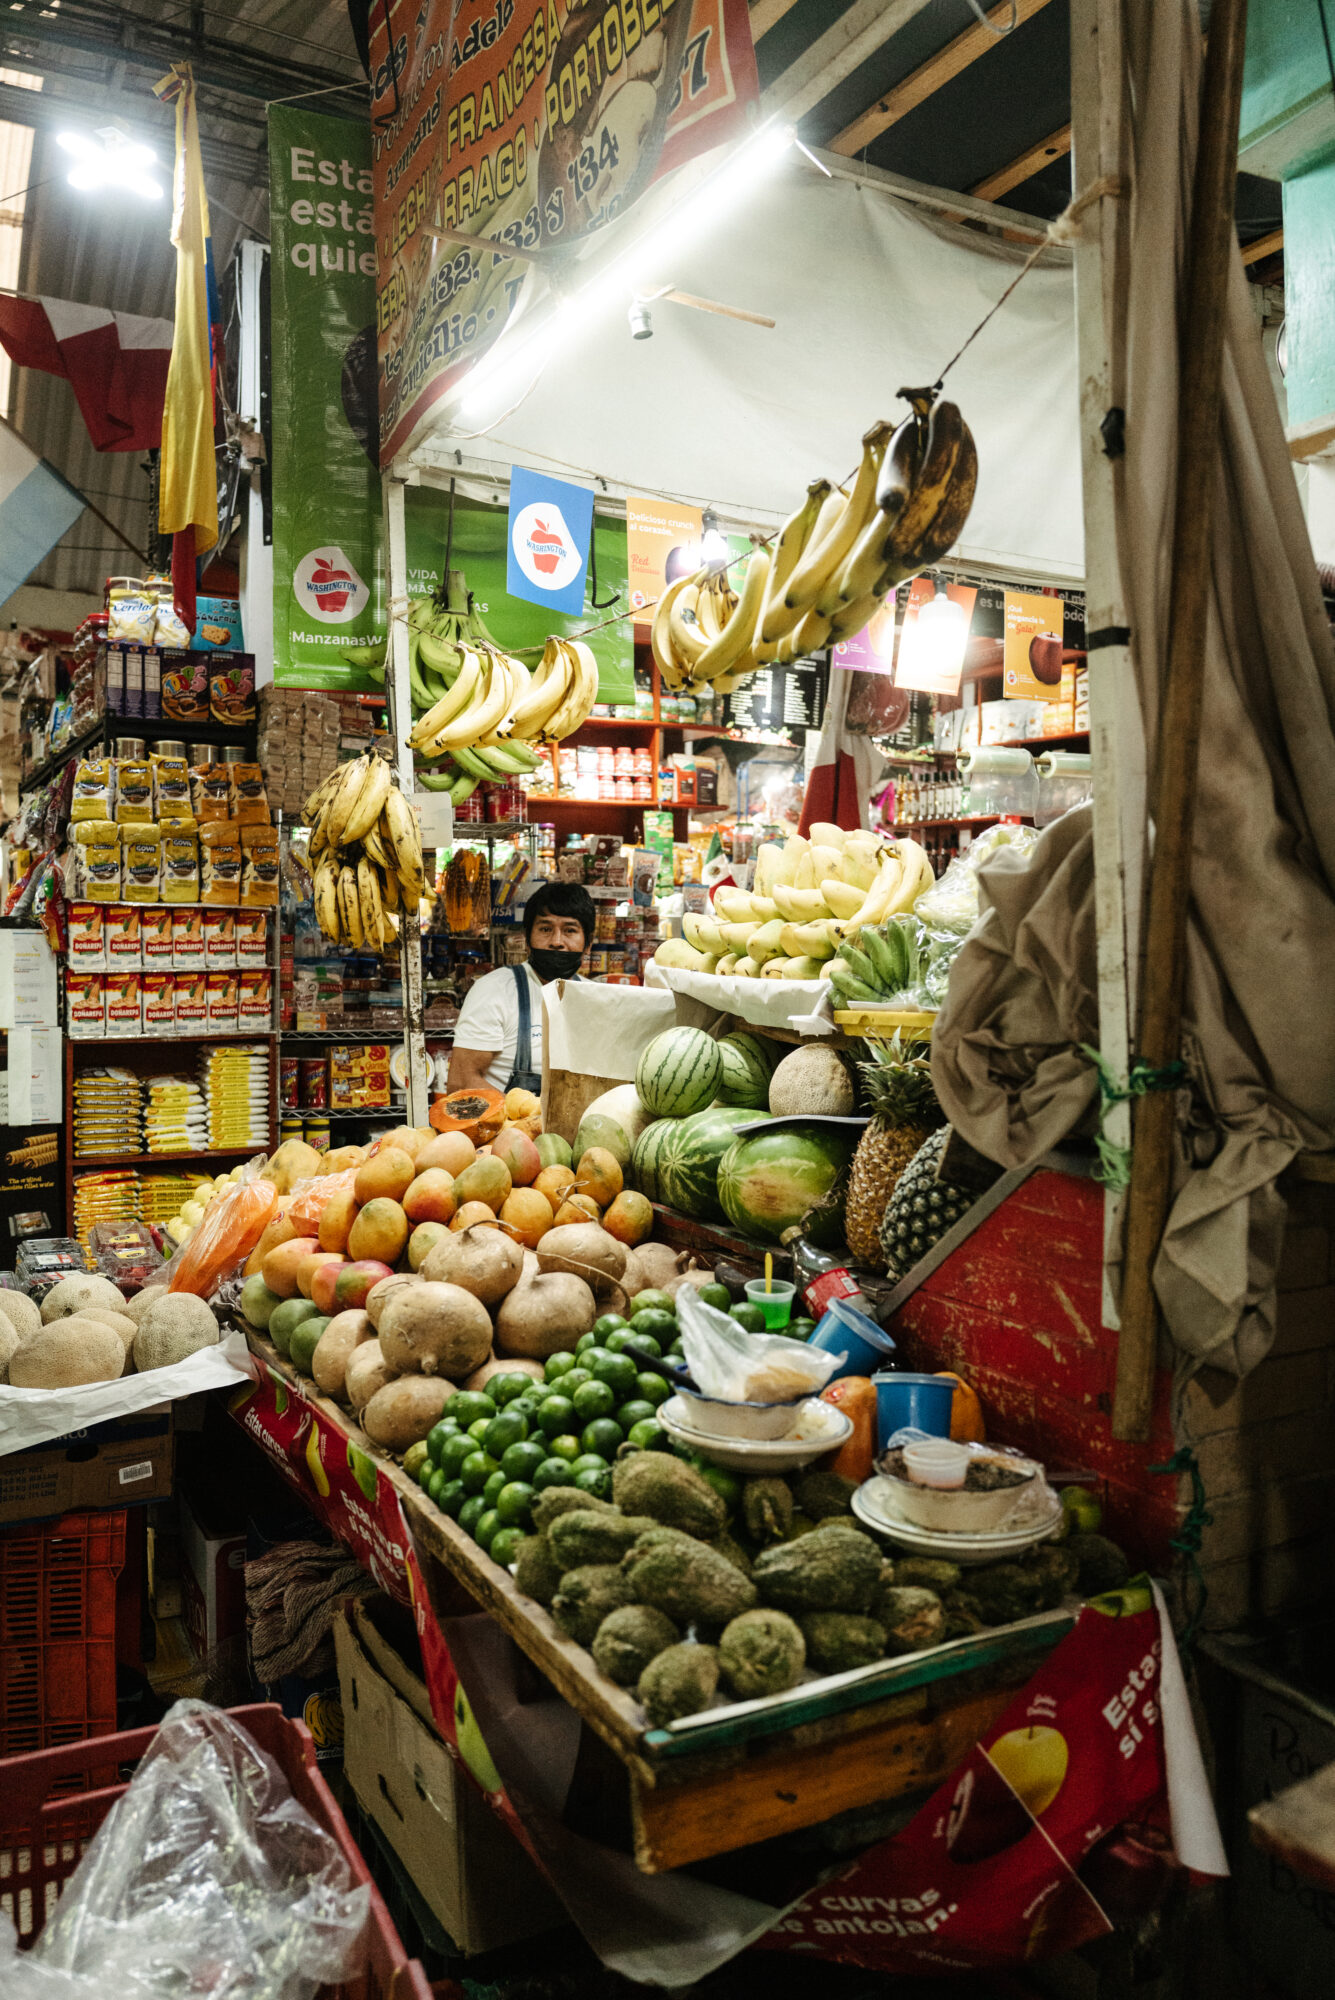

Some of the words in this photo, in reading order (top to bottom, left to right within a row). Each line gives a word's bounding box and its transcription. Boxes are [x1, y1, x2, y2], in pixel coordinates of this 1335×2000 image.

[446, 0, 563, 163] FRANCESA
[567, 125, 620, 203] 134
[399, 312, 479, 402] omicilio
[629, 511, 667, 526] Delicioso
[526, 538, 567, 559] WASHINGTON
[631, 553, 650, 567] Red
[408, 568, 438, 580] VIDA
[306, 580, 358, 593] WASHINGTON
[490, 907, 512, 917] VISA
[1118, 1715, 1144, 1760] sí
[1141, 1699, 1160, 1726] s
[819, 1887, 941, 1914] curvas
[812, 1902, 959, 1938] antojan.
